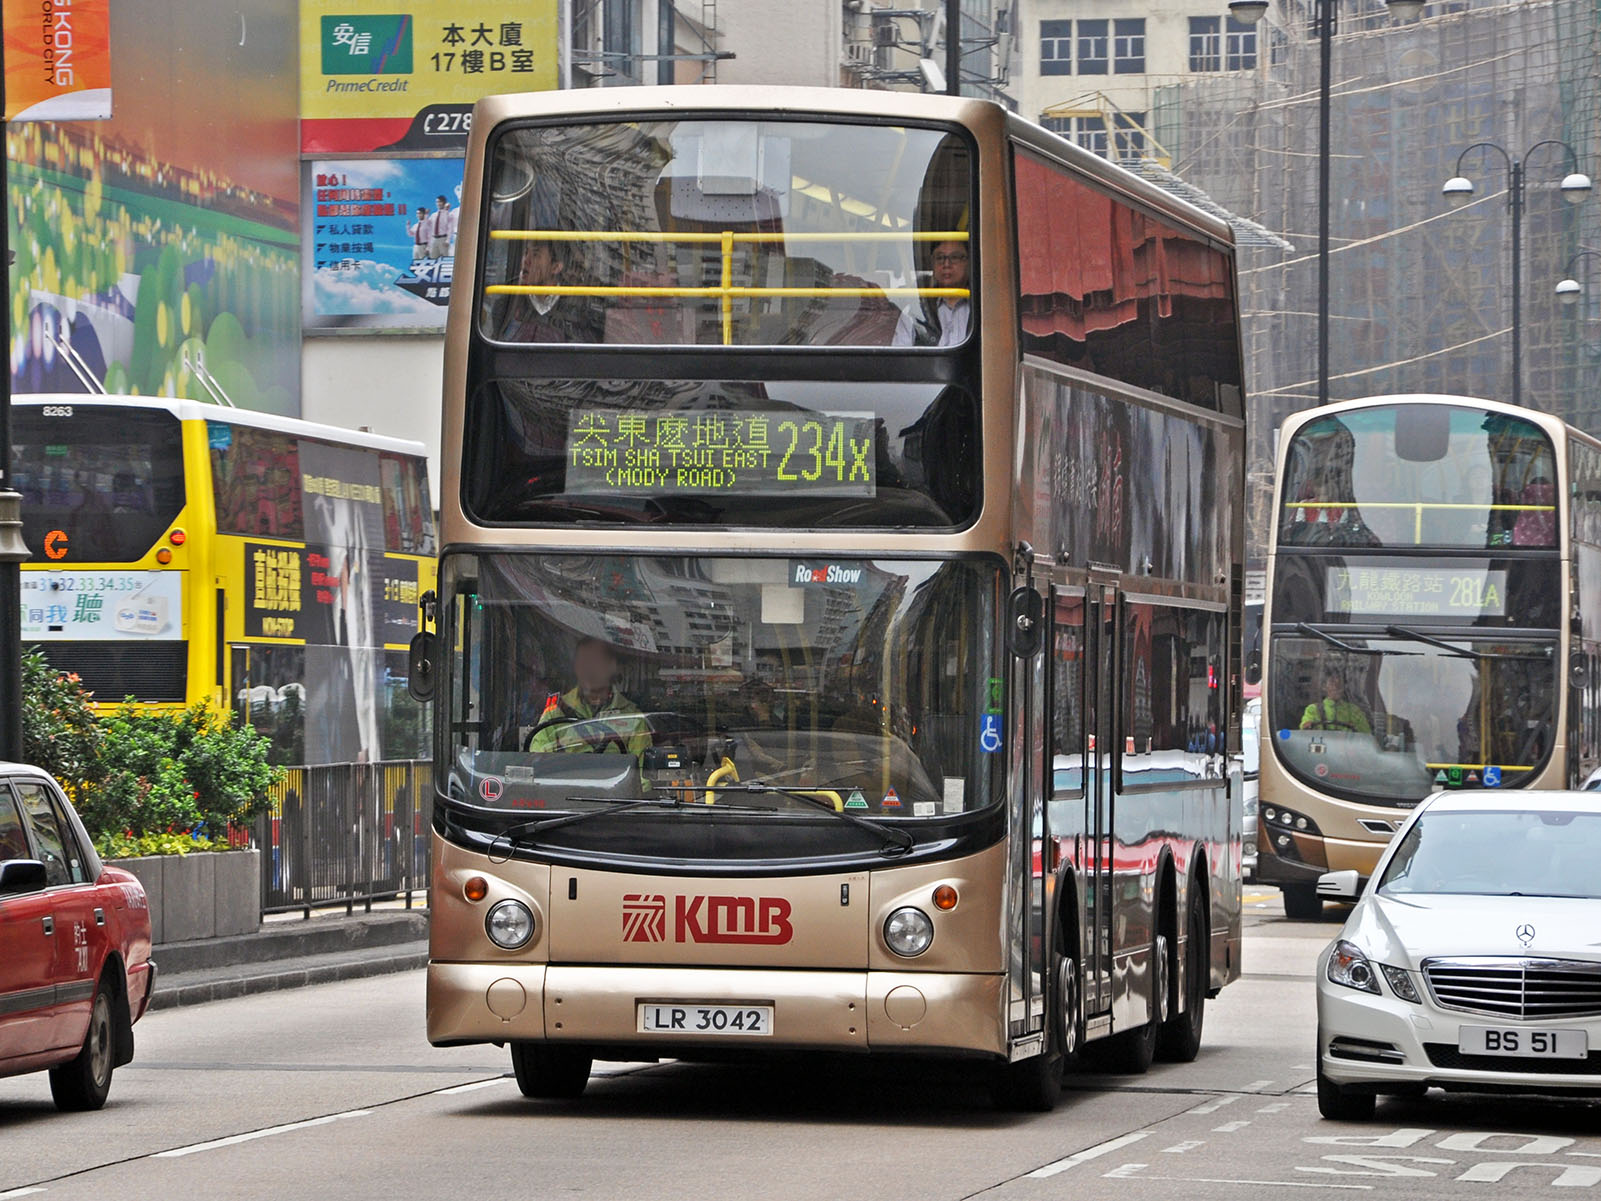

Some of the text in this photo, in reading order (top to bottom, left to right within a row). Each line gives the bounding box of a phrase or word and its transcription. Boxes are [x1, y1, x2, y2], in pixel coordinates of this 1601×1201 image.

[332, 23, 372, 55] 安信
[441, 22, 523, 47] 本大廈
[54, 12, 73, 86] KONG
[43, 48, 55, 85] CITY
[430, 50, 535, 74] 17樓B室
[326, 79, 409, 92] PrimeCredit
[329, 224, 374, 235] 私人貸款
[329, 260, 361, 271] 信用卡
[43, 406, 73, 417] 8263
[570, 448, 771, 468] TSIM SHA TSUI EAST
[606, 468, 736, 487] (MODY ROAD)
[795, 564, 861, 583] RoadShow
[1450, 577, 1500, 608] 281A
[484, 780, 497, 798] L
[675, 895, 793, 945] KMB
[655, 1008, 761, 1031] LR 3042
[1485, 1030, 1557, 1053] BS 51
